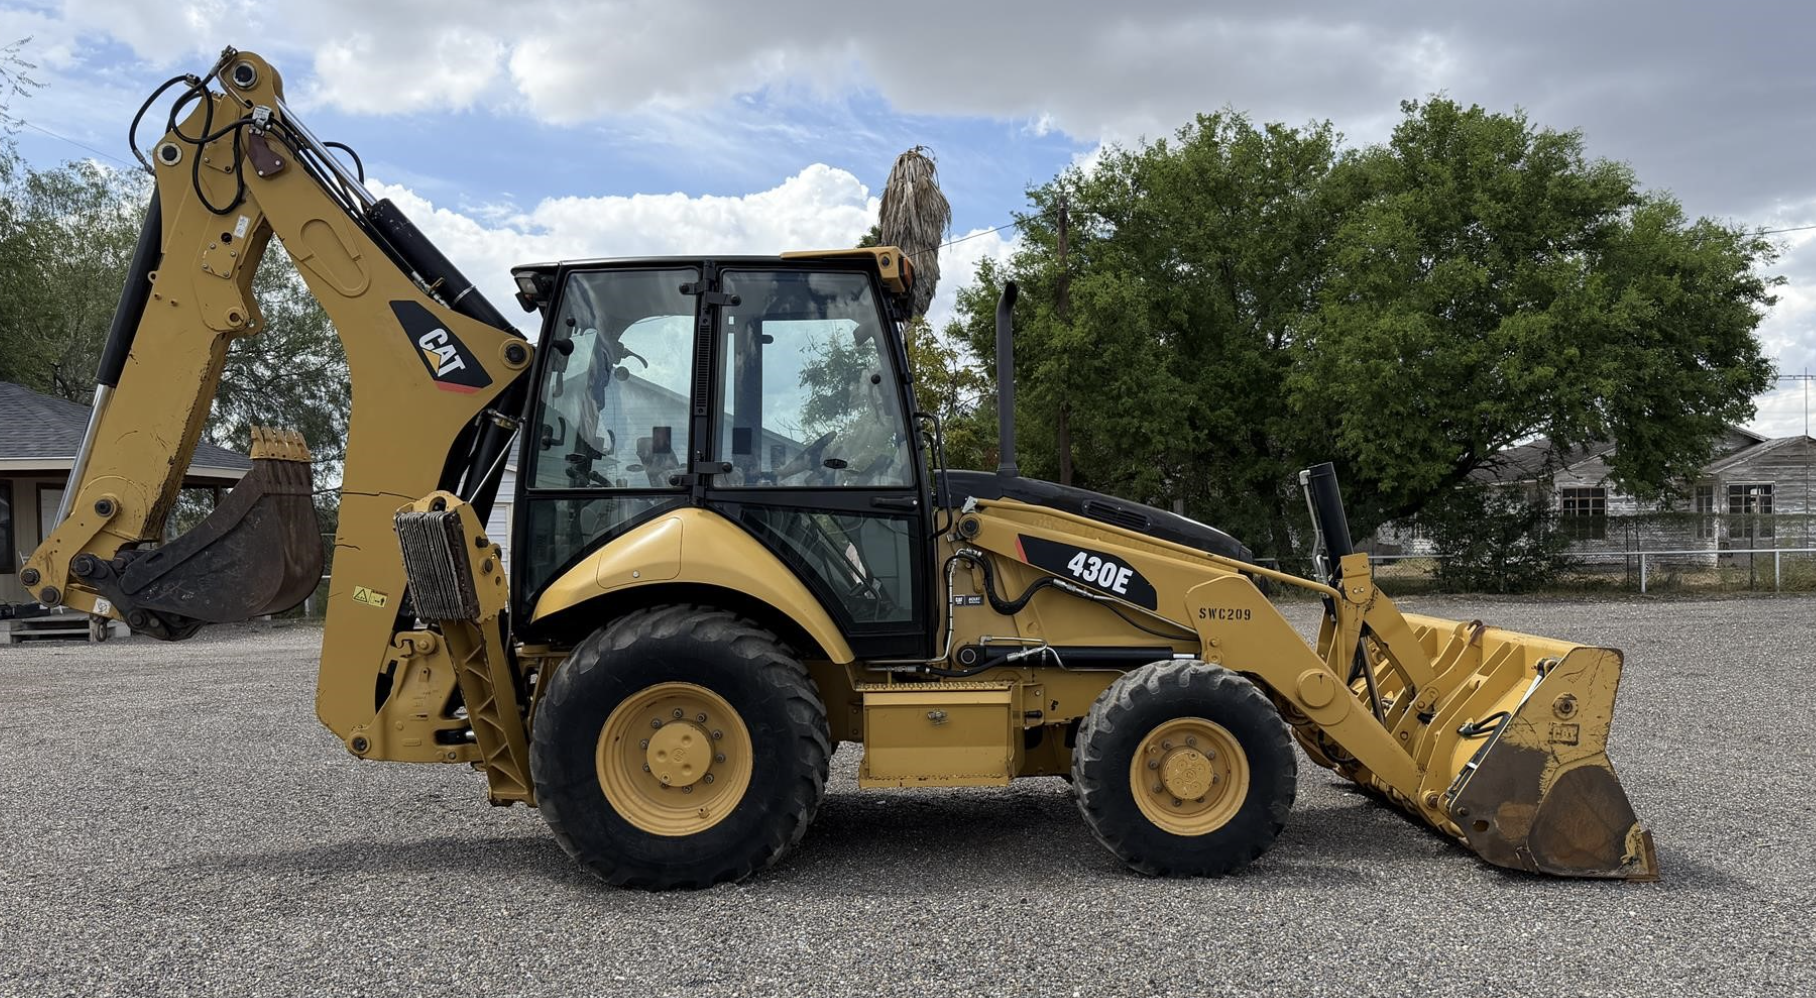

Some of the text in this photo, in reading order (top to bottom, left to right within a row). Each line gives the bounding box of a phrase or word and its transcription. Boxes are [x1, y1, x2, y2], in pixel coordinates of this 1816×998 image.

[418, 328, 466, 377] CAT
[1067, 551, 1133, 595] 430E
[1199, 607, 1251, 621] SWC209
